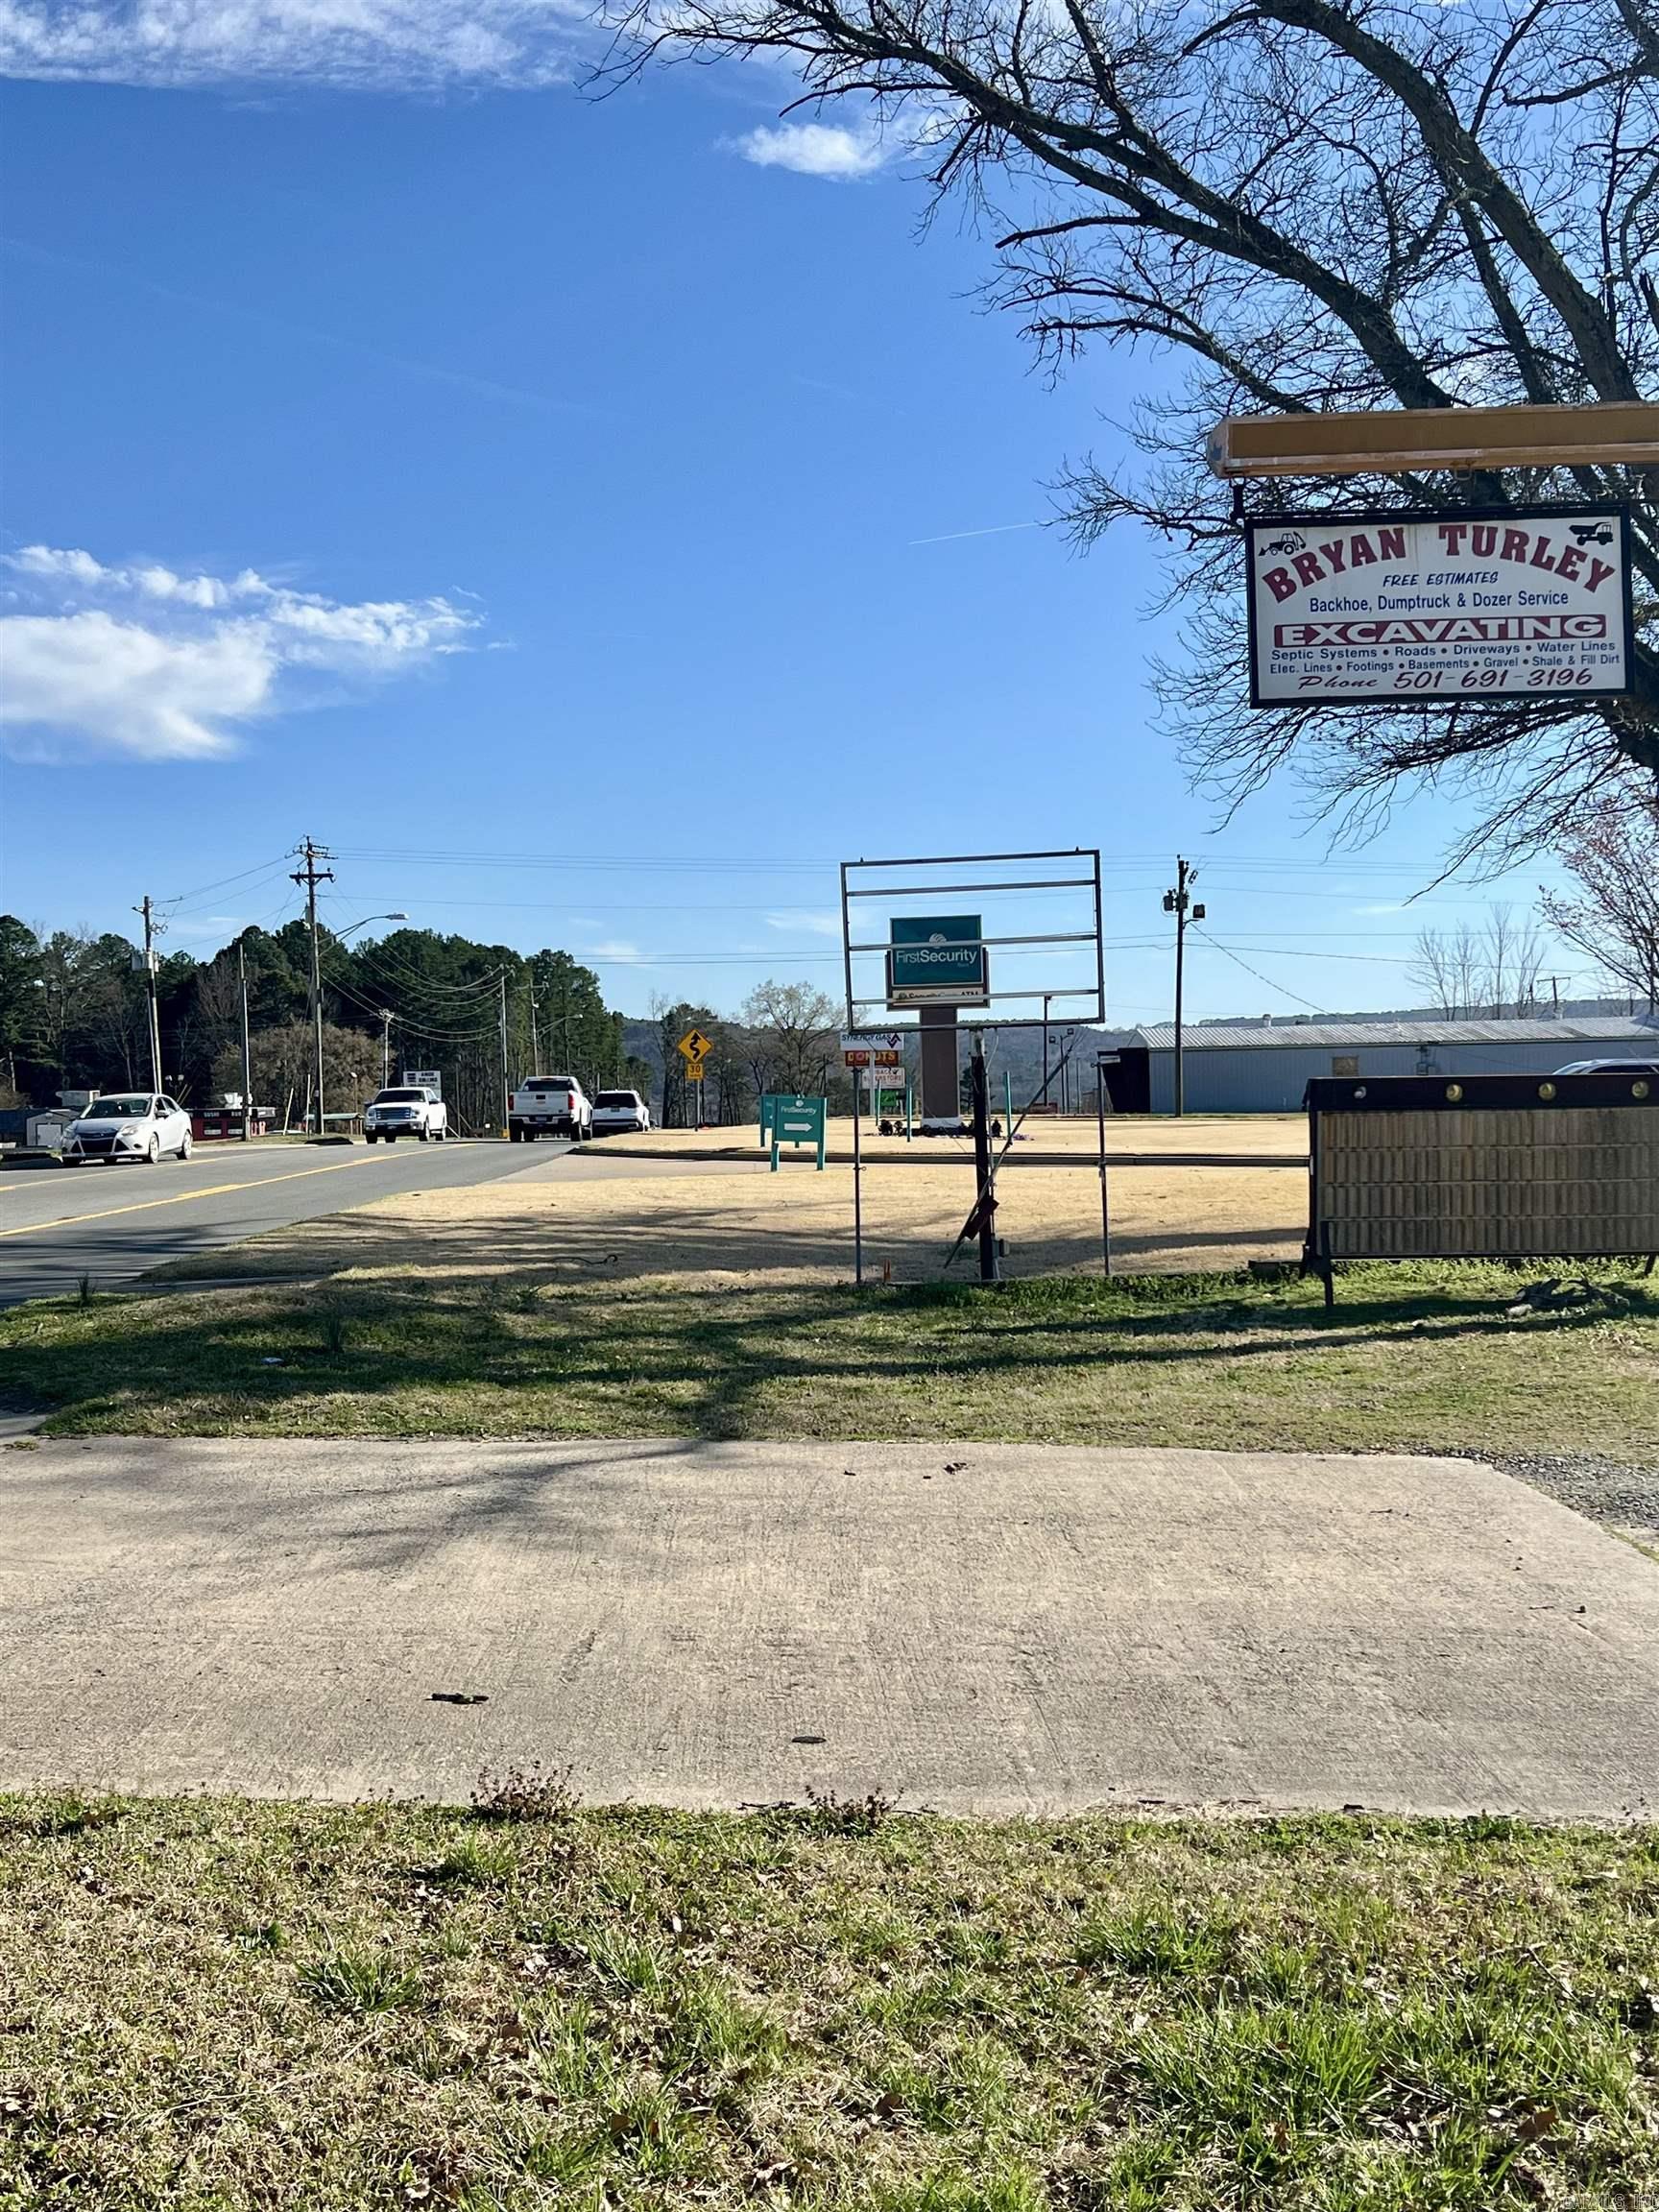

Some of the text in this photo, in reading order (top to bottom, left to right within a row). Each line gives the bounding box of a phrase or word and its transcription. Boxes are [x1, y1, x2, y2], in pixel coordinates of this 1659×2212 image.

[1262, 524, 1616, 604] BRYAN TURLEY
[1382, 571, 1499, 588] FREE ESTIMATES
[1310, 589, 1569, 613] Backhoe, Dumptruck & Dozer Service
[1281, 615, 1603, 646] EXCAVATING
[1271, 640, 1616, 661] Septic Systems Roads Driveways Water Lines
[1270, 654, 1620, 674] Elec. Lines Footings Basements Gravel Shale & Fill Dirt
[1298, 668, 1593, 690] Phone 501-691-3196
[896, 949, 977, 964] FirstSecurity
[689, 1065, 701, 1073] 30
